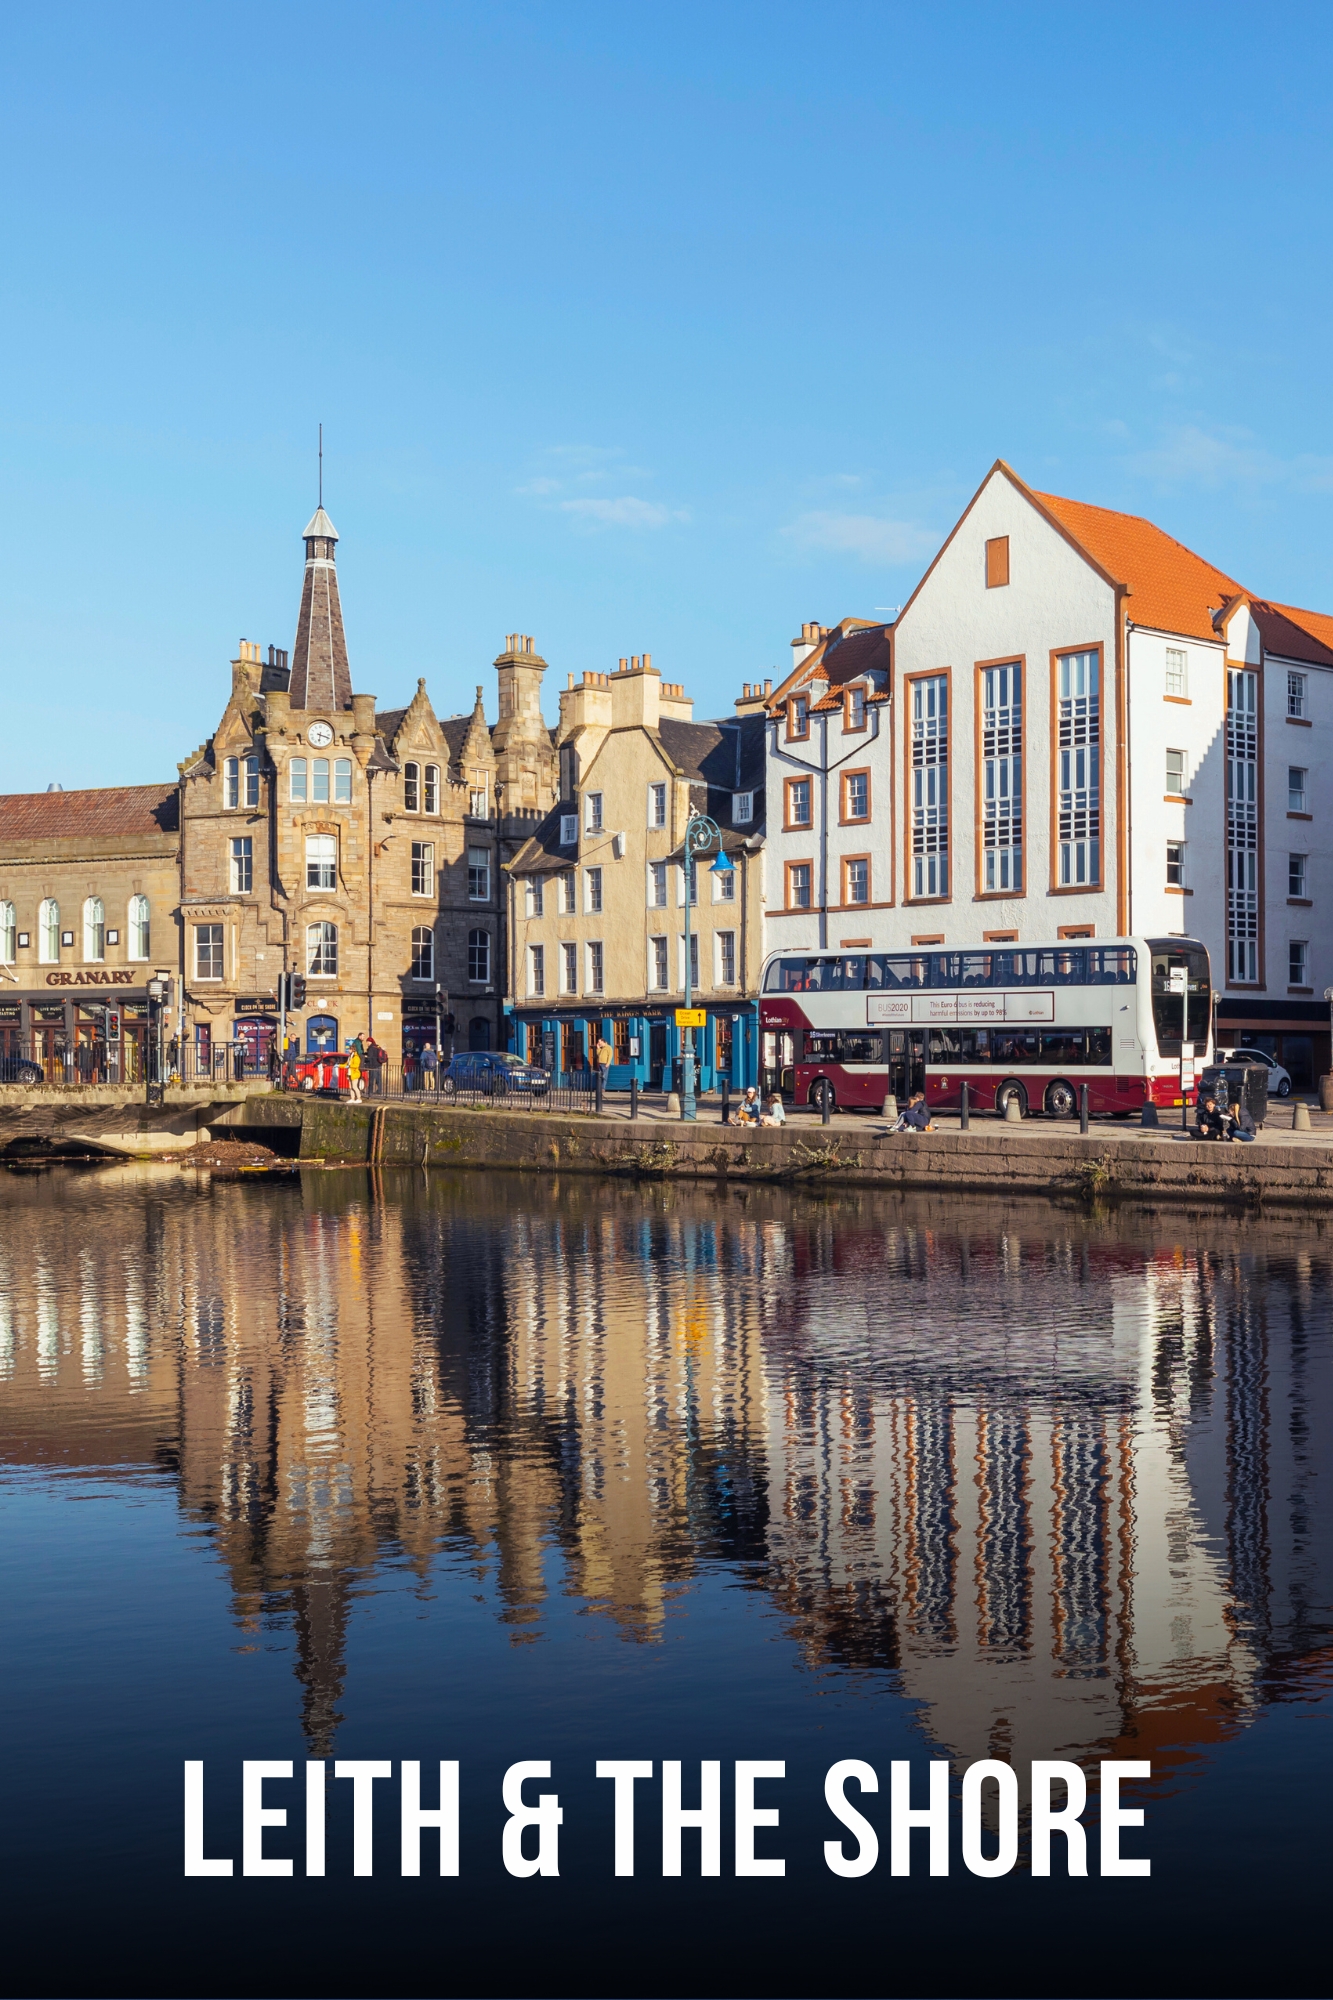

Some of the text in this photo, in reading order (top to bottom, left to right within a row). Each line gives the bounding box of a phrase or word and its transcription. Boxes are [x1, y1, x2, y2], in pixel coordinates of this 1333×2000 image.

[46, 971, 136, 985] GRANARY
[878, 1003, 908, 1012] BUS2020
[974, 1009, 980, 1017] by
